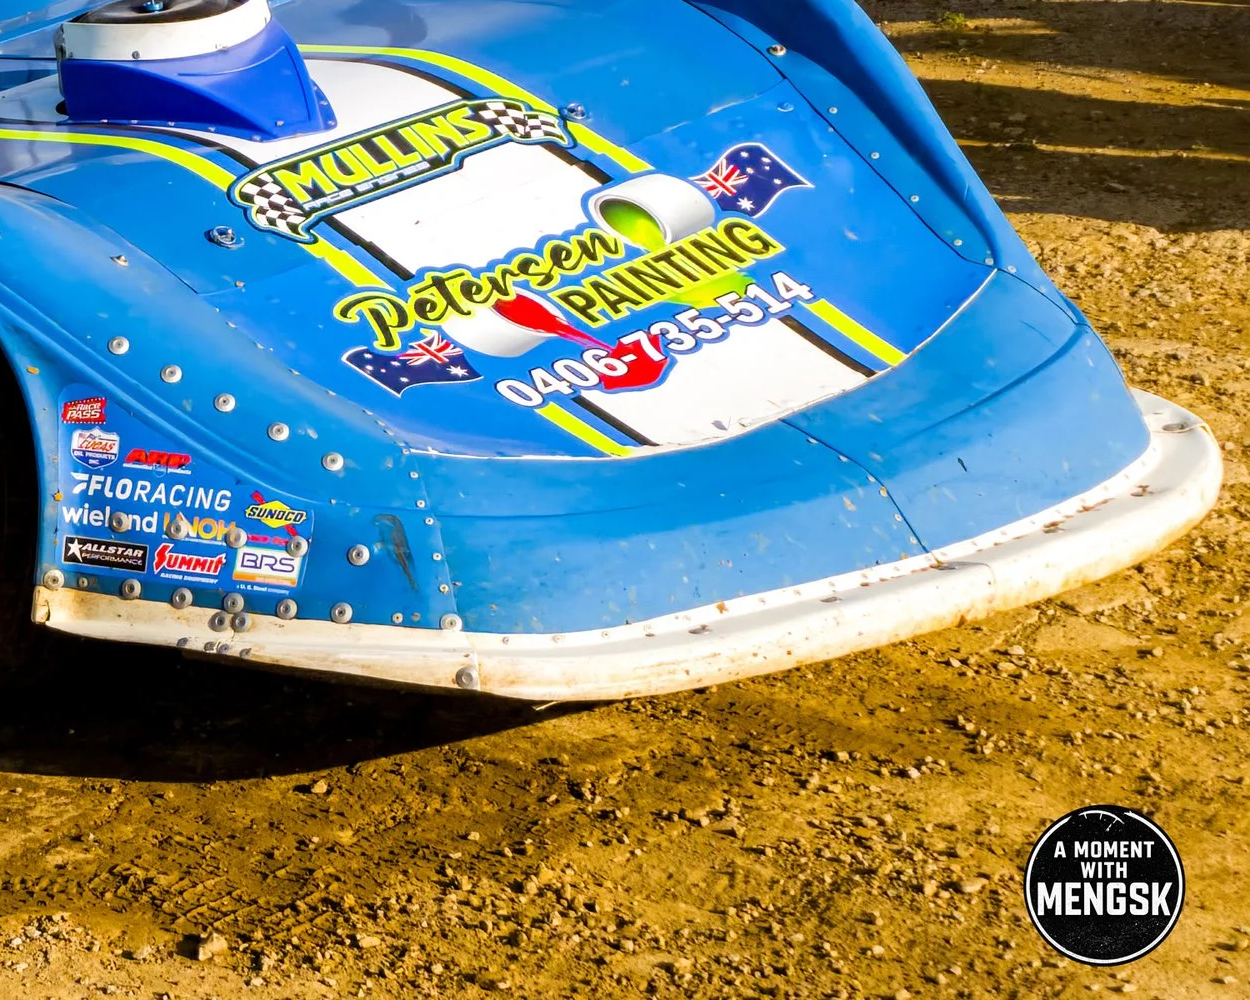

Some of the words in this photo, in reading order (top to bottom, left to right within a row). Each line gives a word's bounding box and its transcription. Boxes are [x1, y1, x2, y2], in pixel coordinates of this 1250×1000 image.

[273, 106, 491, 202] MULLINS
[556, 219, 777, 323] PAINTING
[337, 230, 621, 348] Petersen
[498, 272, 812, 408] 0406-735-514
[66, 409, 102, 420] PASS
[78, 439, 116, 452] LUCAS
[125, 448, 192, 469] ARP
[87, 474, 232, 512] FLORACING
[62, 502, 159, 533] wielnd
[248, 506, 305, 523] SUNOCO
[81, 542, 144, 558] ALLSTAR
[81, 551, 143, 566] PERFORMANCE
[240, 552, 295, 573] BRS
